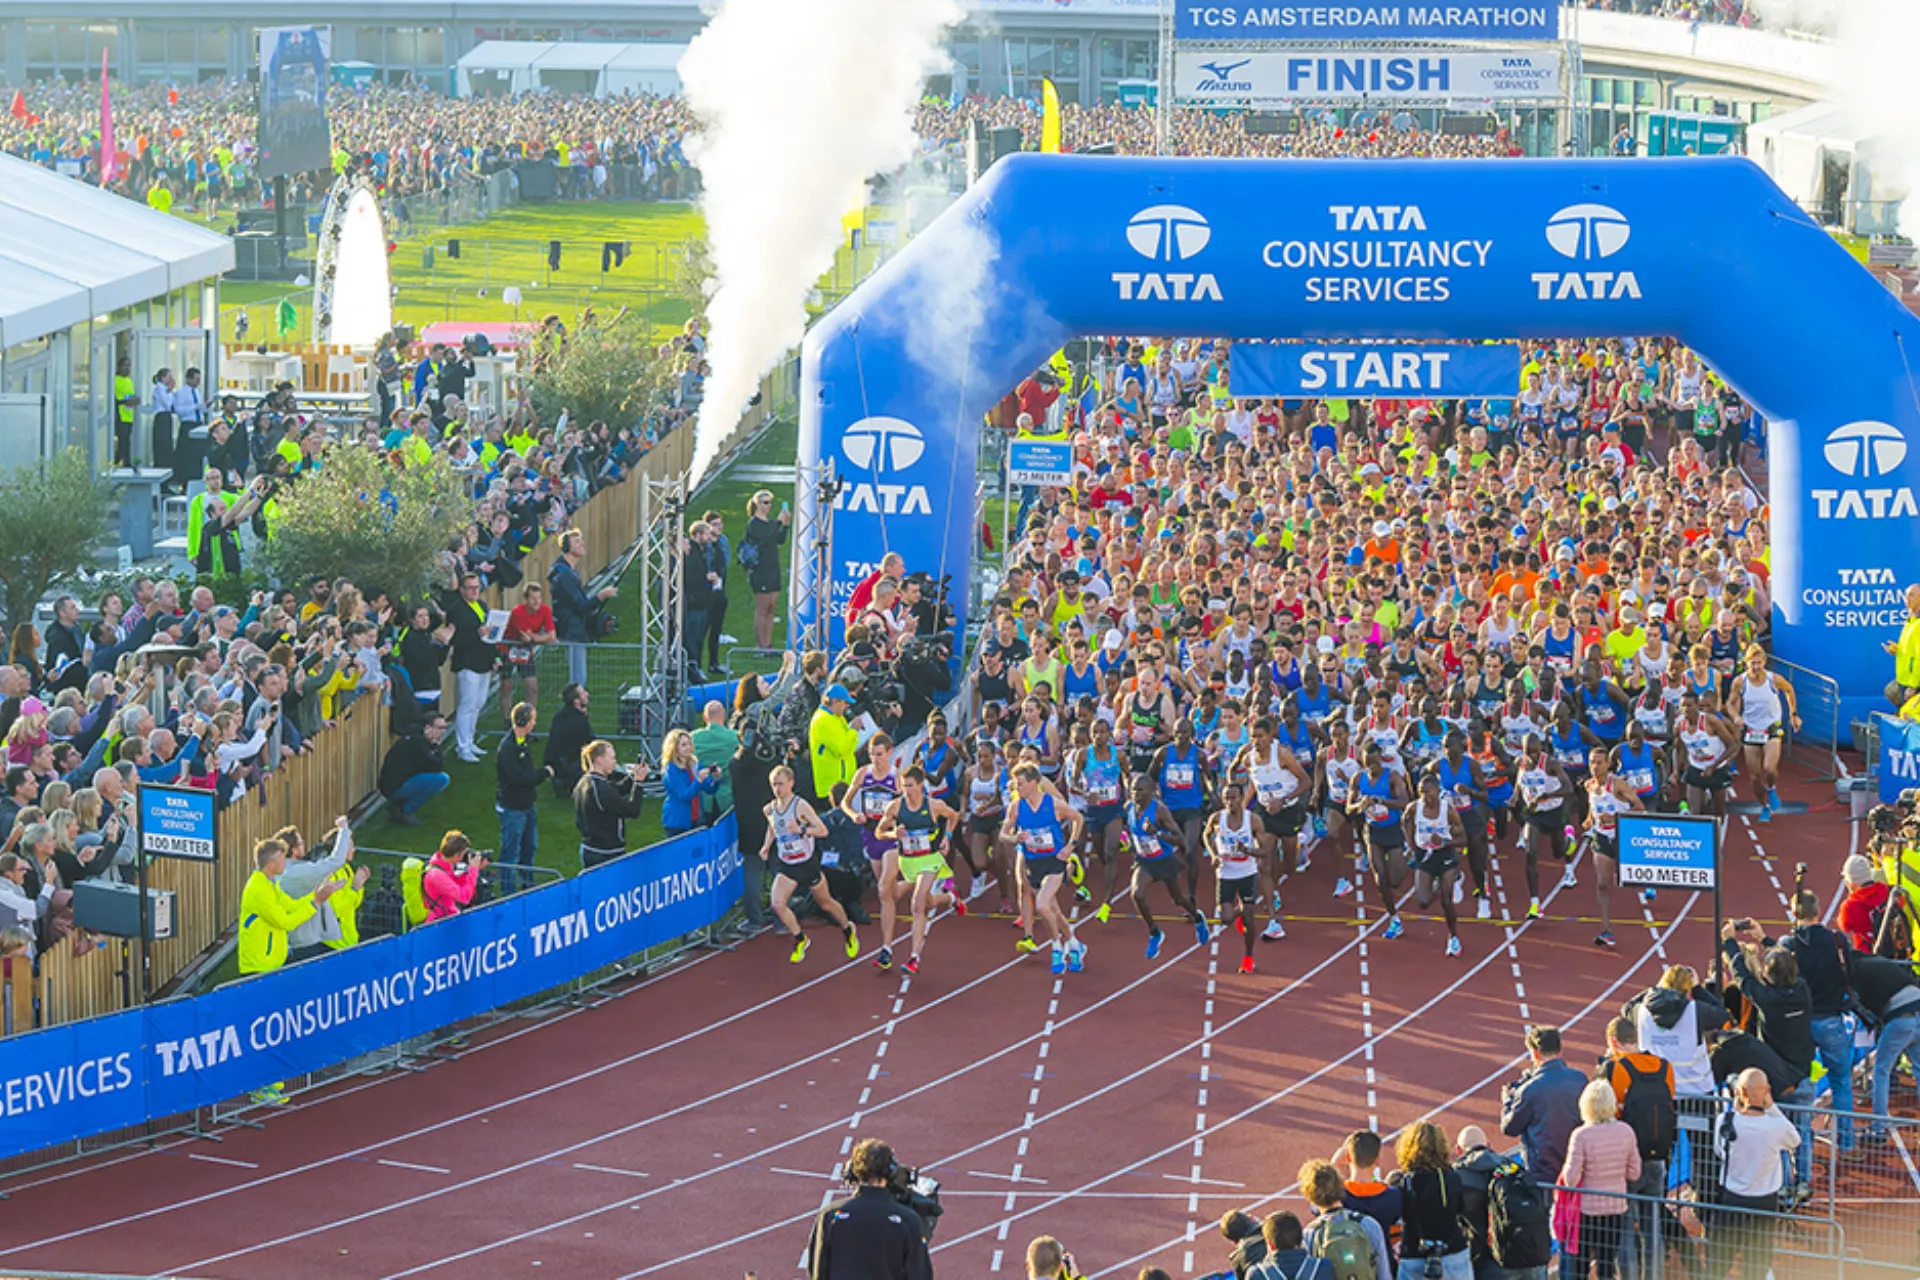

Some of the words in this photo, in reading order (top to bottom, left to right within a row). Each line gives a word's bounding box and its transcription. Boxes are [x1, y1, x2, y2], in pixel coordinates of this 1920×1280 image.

[1188, 7, 1237, 26] TCS
[1243, 7, 1400, 26] AMSTERDAM
[1408, 7, 1546, 26] MARATHON
[1502, 58, 1532, 67] TATA
[1287, 58, 1450, 91] FINISH
[1480, 69, 1552, 79] CONSULTANCY
[1494, 80, 1540, 90] SERVICES
[1329, 206, 1427, 231] TATA
[1262, 240, 1493, 268] CONSULTANCY
[1111, 272, 1224, 301] TATA
[1305, 276, 1451, 302] SERVICES
[1531, 271, 1643, 300] TATA
[1300, 352, 1450, 389] START
[1811, 488, 1919, 519] TATA
[1838, 568, 1896, 585] TATA
[165, 796, 189, 808] TATA
[150, 806, 204, 822] CONSULTANCY
[161, 819, 196, 832] SERVICES
[1650, 826, 1682, 837] TATA
[148, 836, 169, 849] 100
[171, 838, 211, 854] METER
[1630, 836, 1702, 851] CONSULTANCY
[1643, 848, 1690, 861] SERVICES
[1627, 867, 1653, 881] 100
[1656, 868, 1709, 884] METER
[0, 1052, 132, 1118] ERVICES
[156, 1025, 243, 1077] TATA
[250, 966, 418, 1051] CONSULTANCY
[423, 933, 518, 997] SERVICES
[530, 909, 590, 957] TATA
[594, 859, 716, 933] CONSULTANCY
